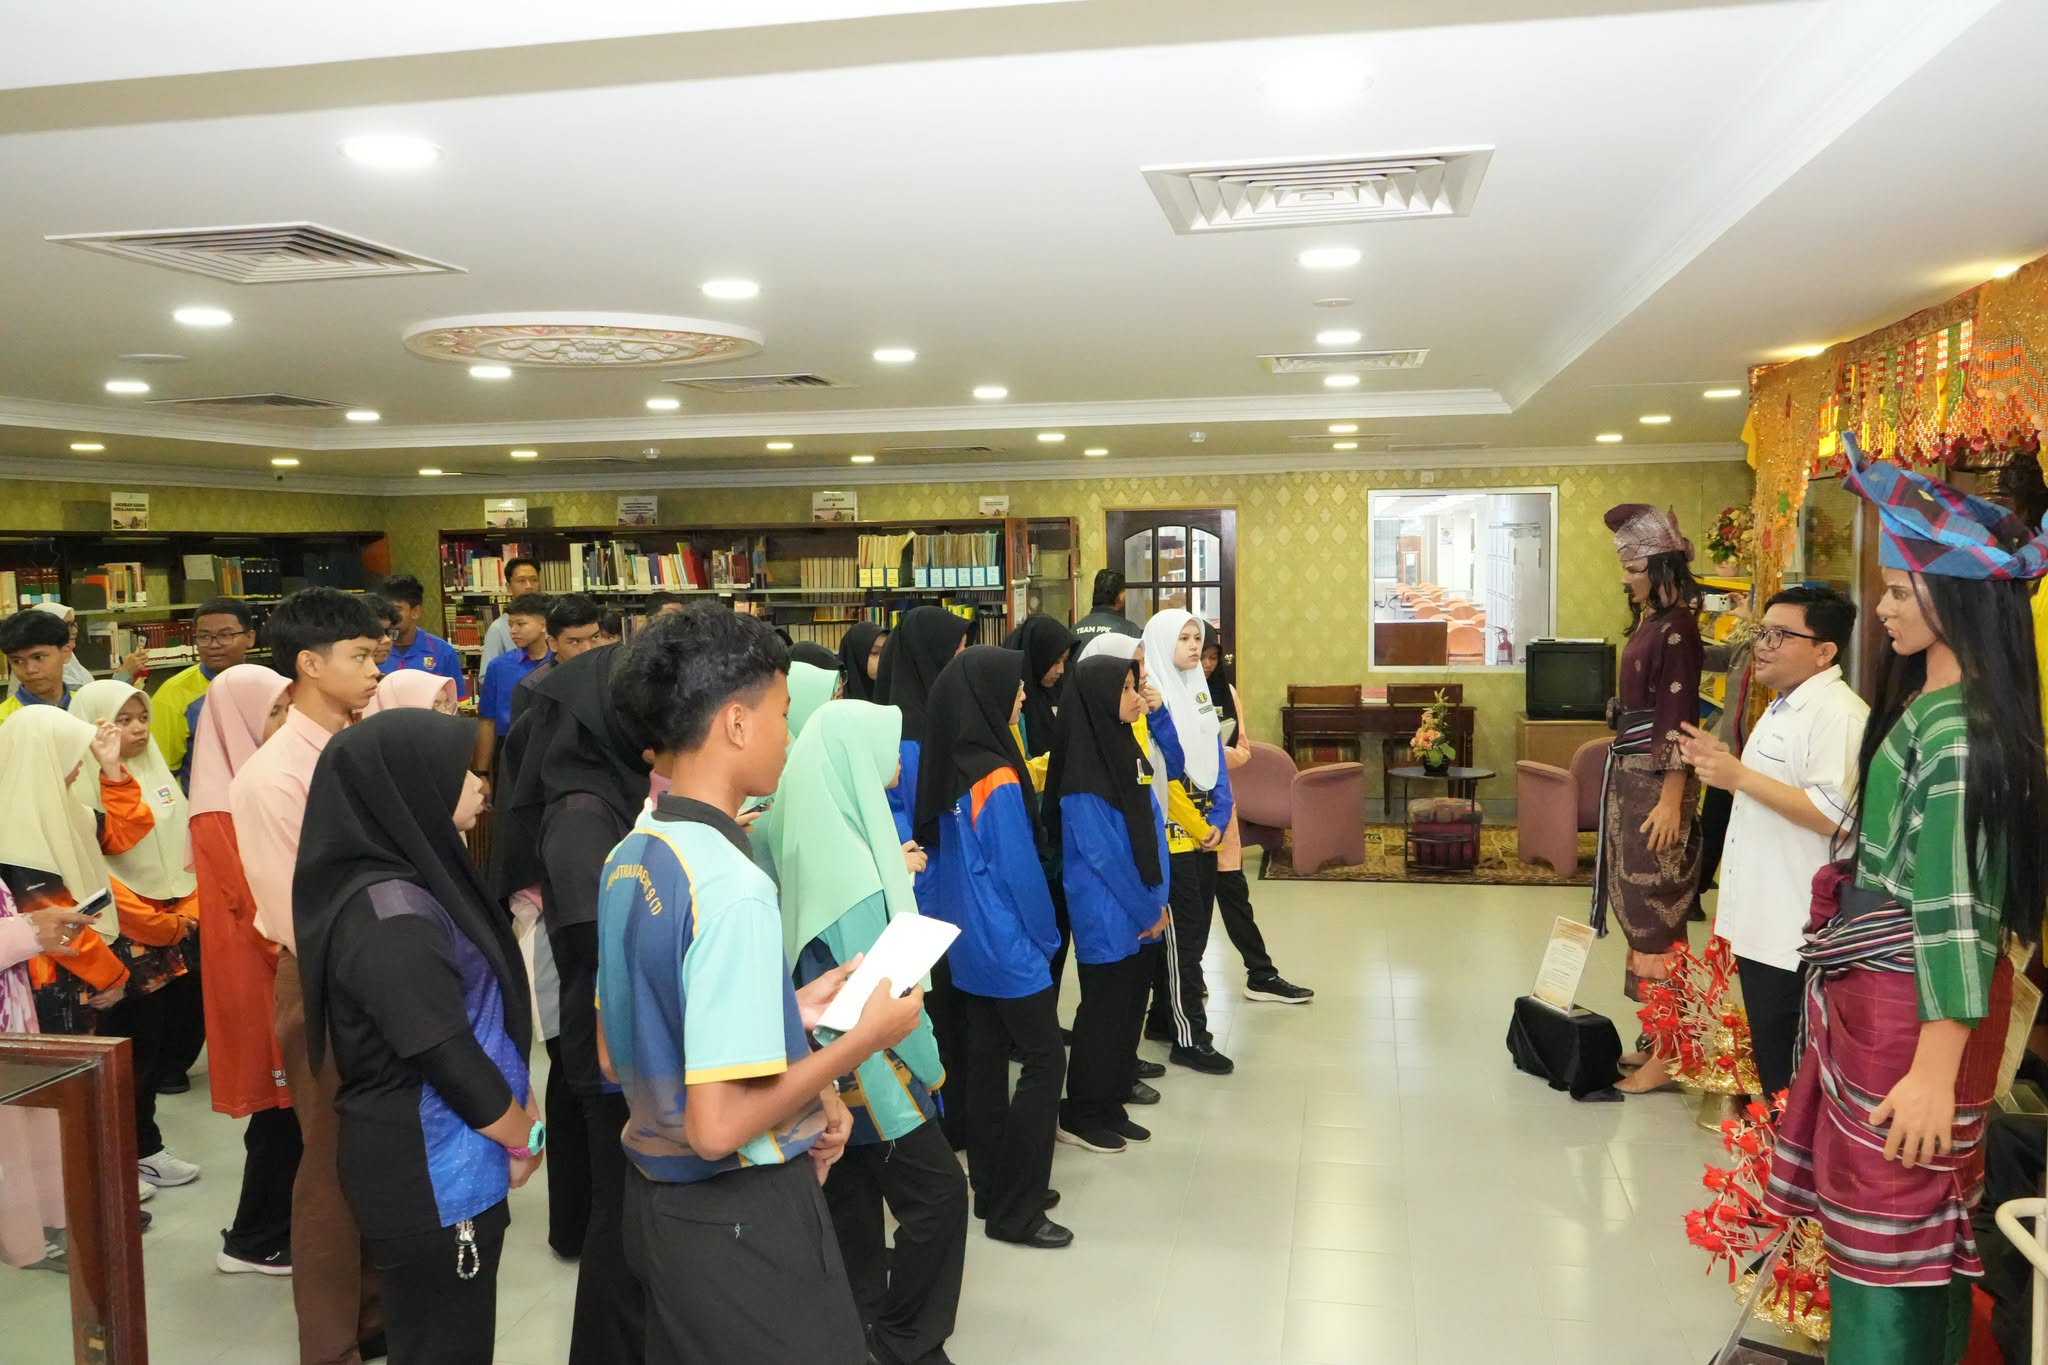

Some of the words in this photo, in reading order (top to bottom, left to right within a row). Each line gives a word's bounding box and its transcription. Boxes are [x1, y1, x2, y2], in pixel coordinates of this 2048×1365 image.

[1076, 626, 1096, 635] TEAM
[1096, 625, 1112, 634] PPK
[645, 887, 656, 901] 9
